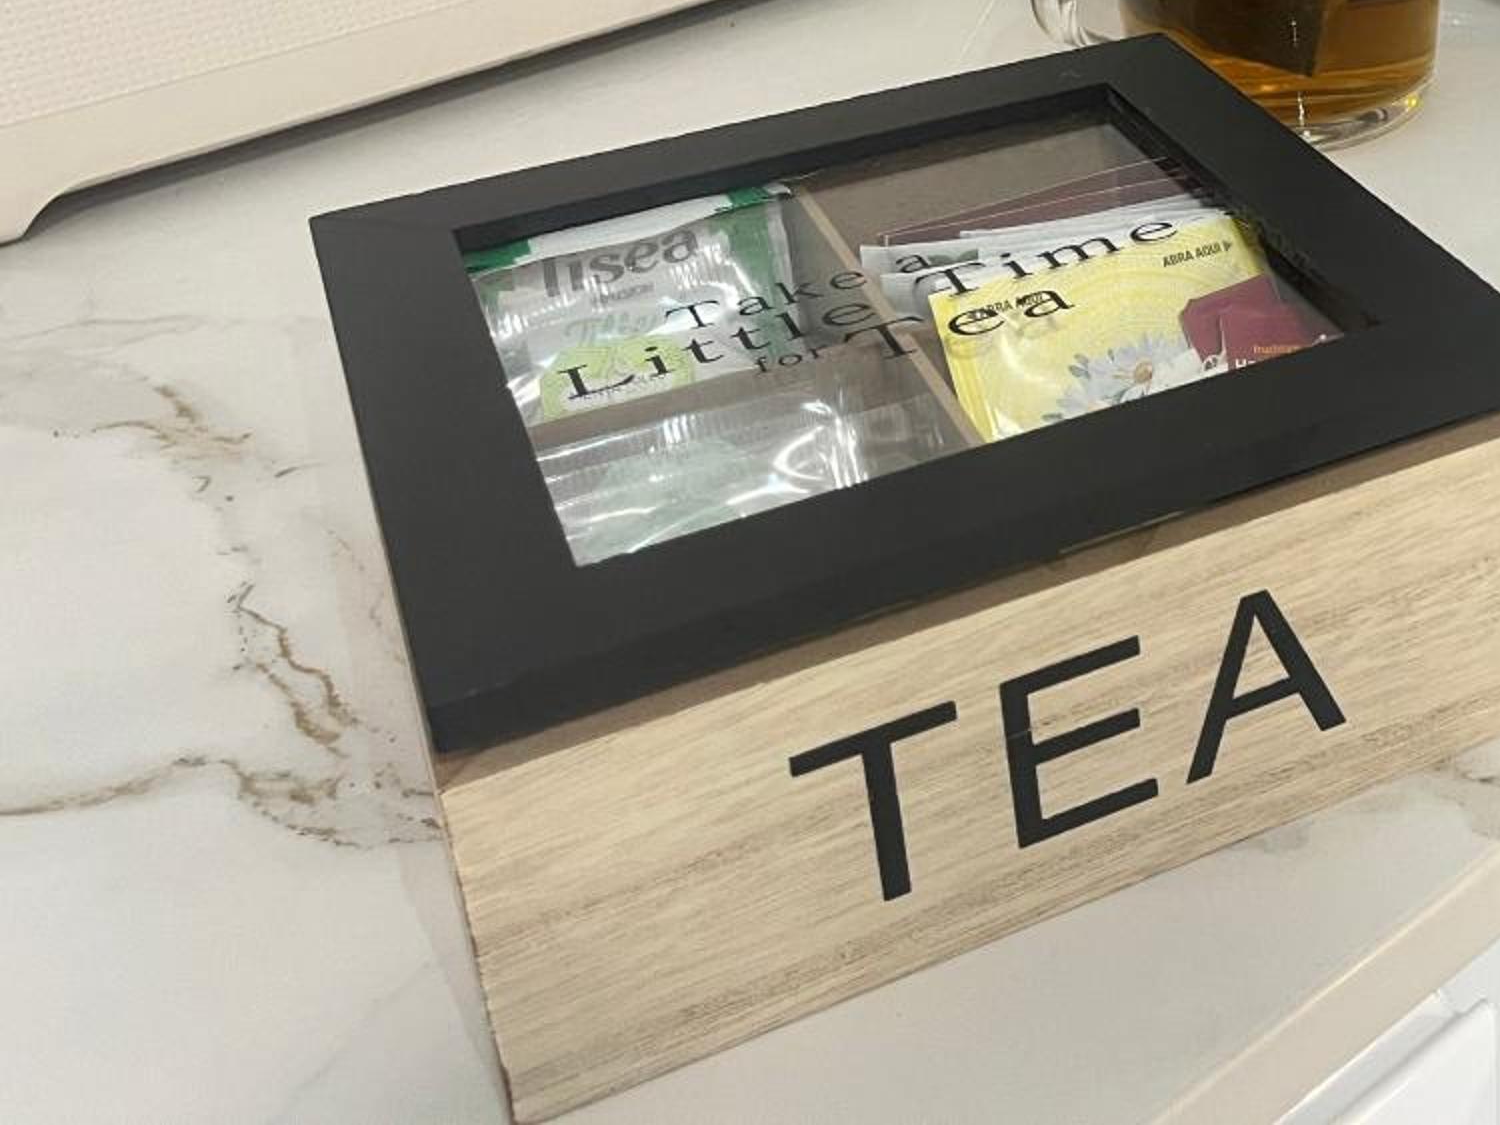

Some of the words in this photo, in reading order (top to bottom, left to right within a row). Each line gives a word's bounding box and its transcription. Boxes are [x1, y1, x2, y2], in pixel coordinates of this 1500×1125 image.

[556, 303, 878, 400] Little
[914, 221, 1179, 296] Time
[664, 270, 865, 328] Take
[895, 253, 930, 274] a
[754, 342, 833, 374] for
[844, 289, 1076, 360] Tea
[788, 589, 1347, 902] TEA
